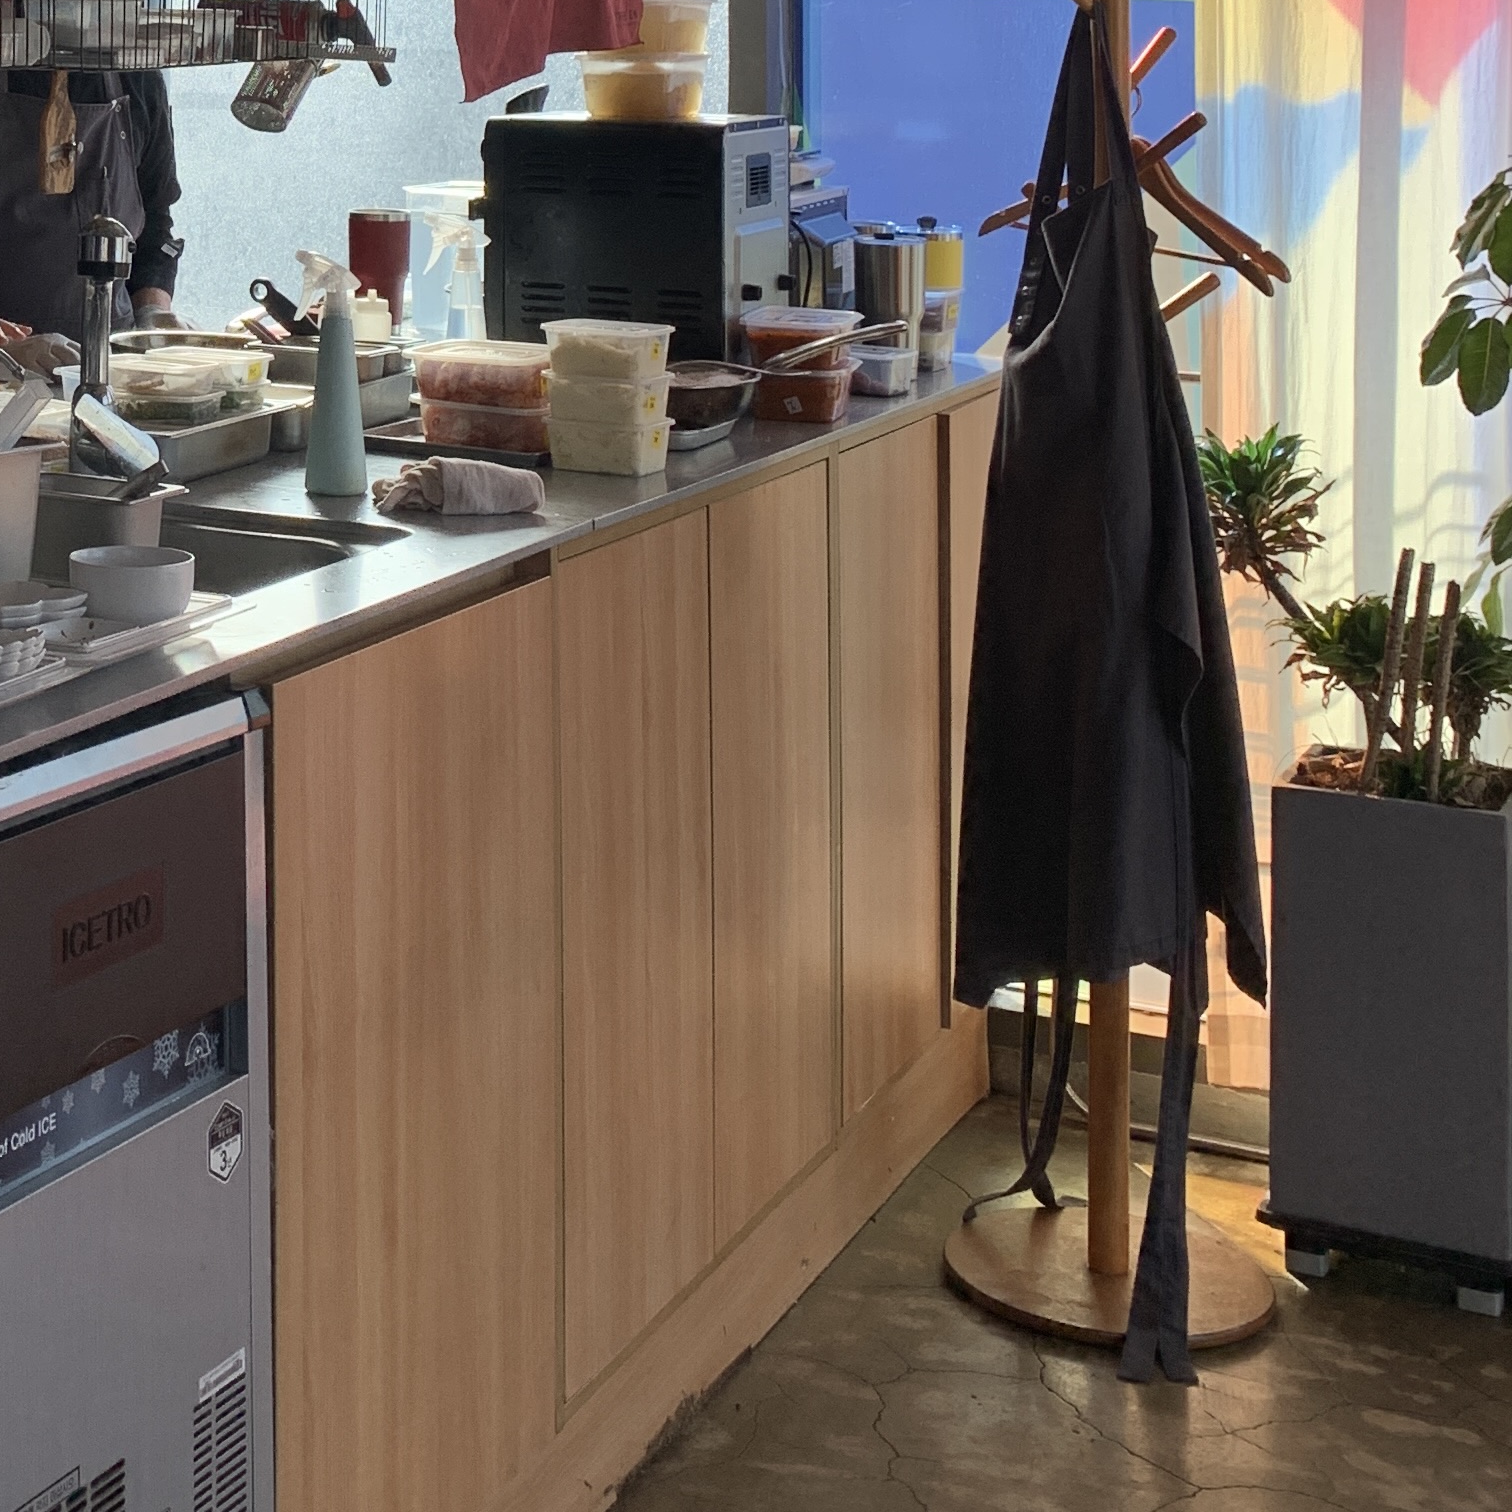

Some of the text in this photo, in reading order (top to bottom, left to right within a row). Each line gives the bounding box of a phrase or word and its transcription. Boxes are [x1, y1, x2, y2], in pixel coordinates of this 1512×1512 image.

[61, 893, 152, 963] ICETRO
[10, 1123, 36, 1151] Cold
[37, 1112, 57, 1137] ICE
